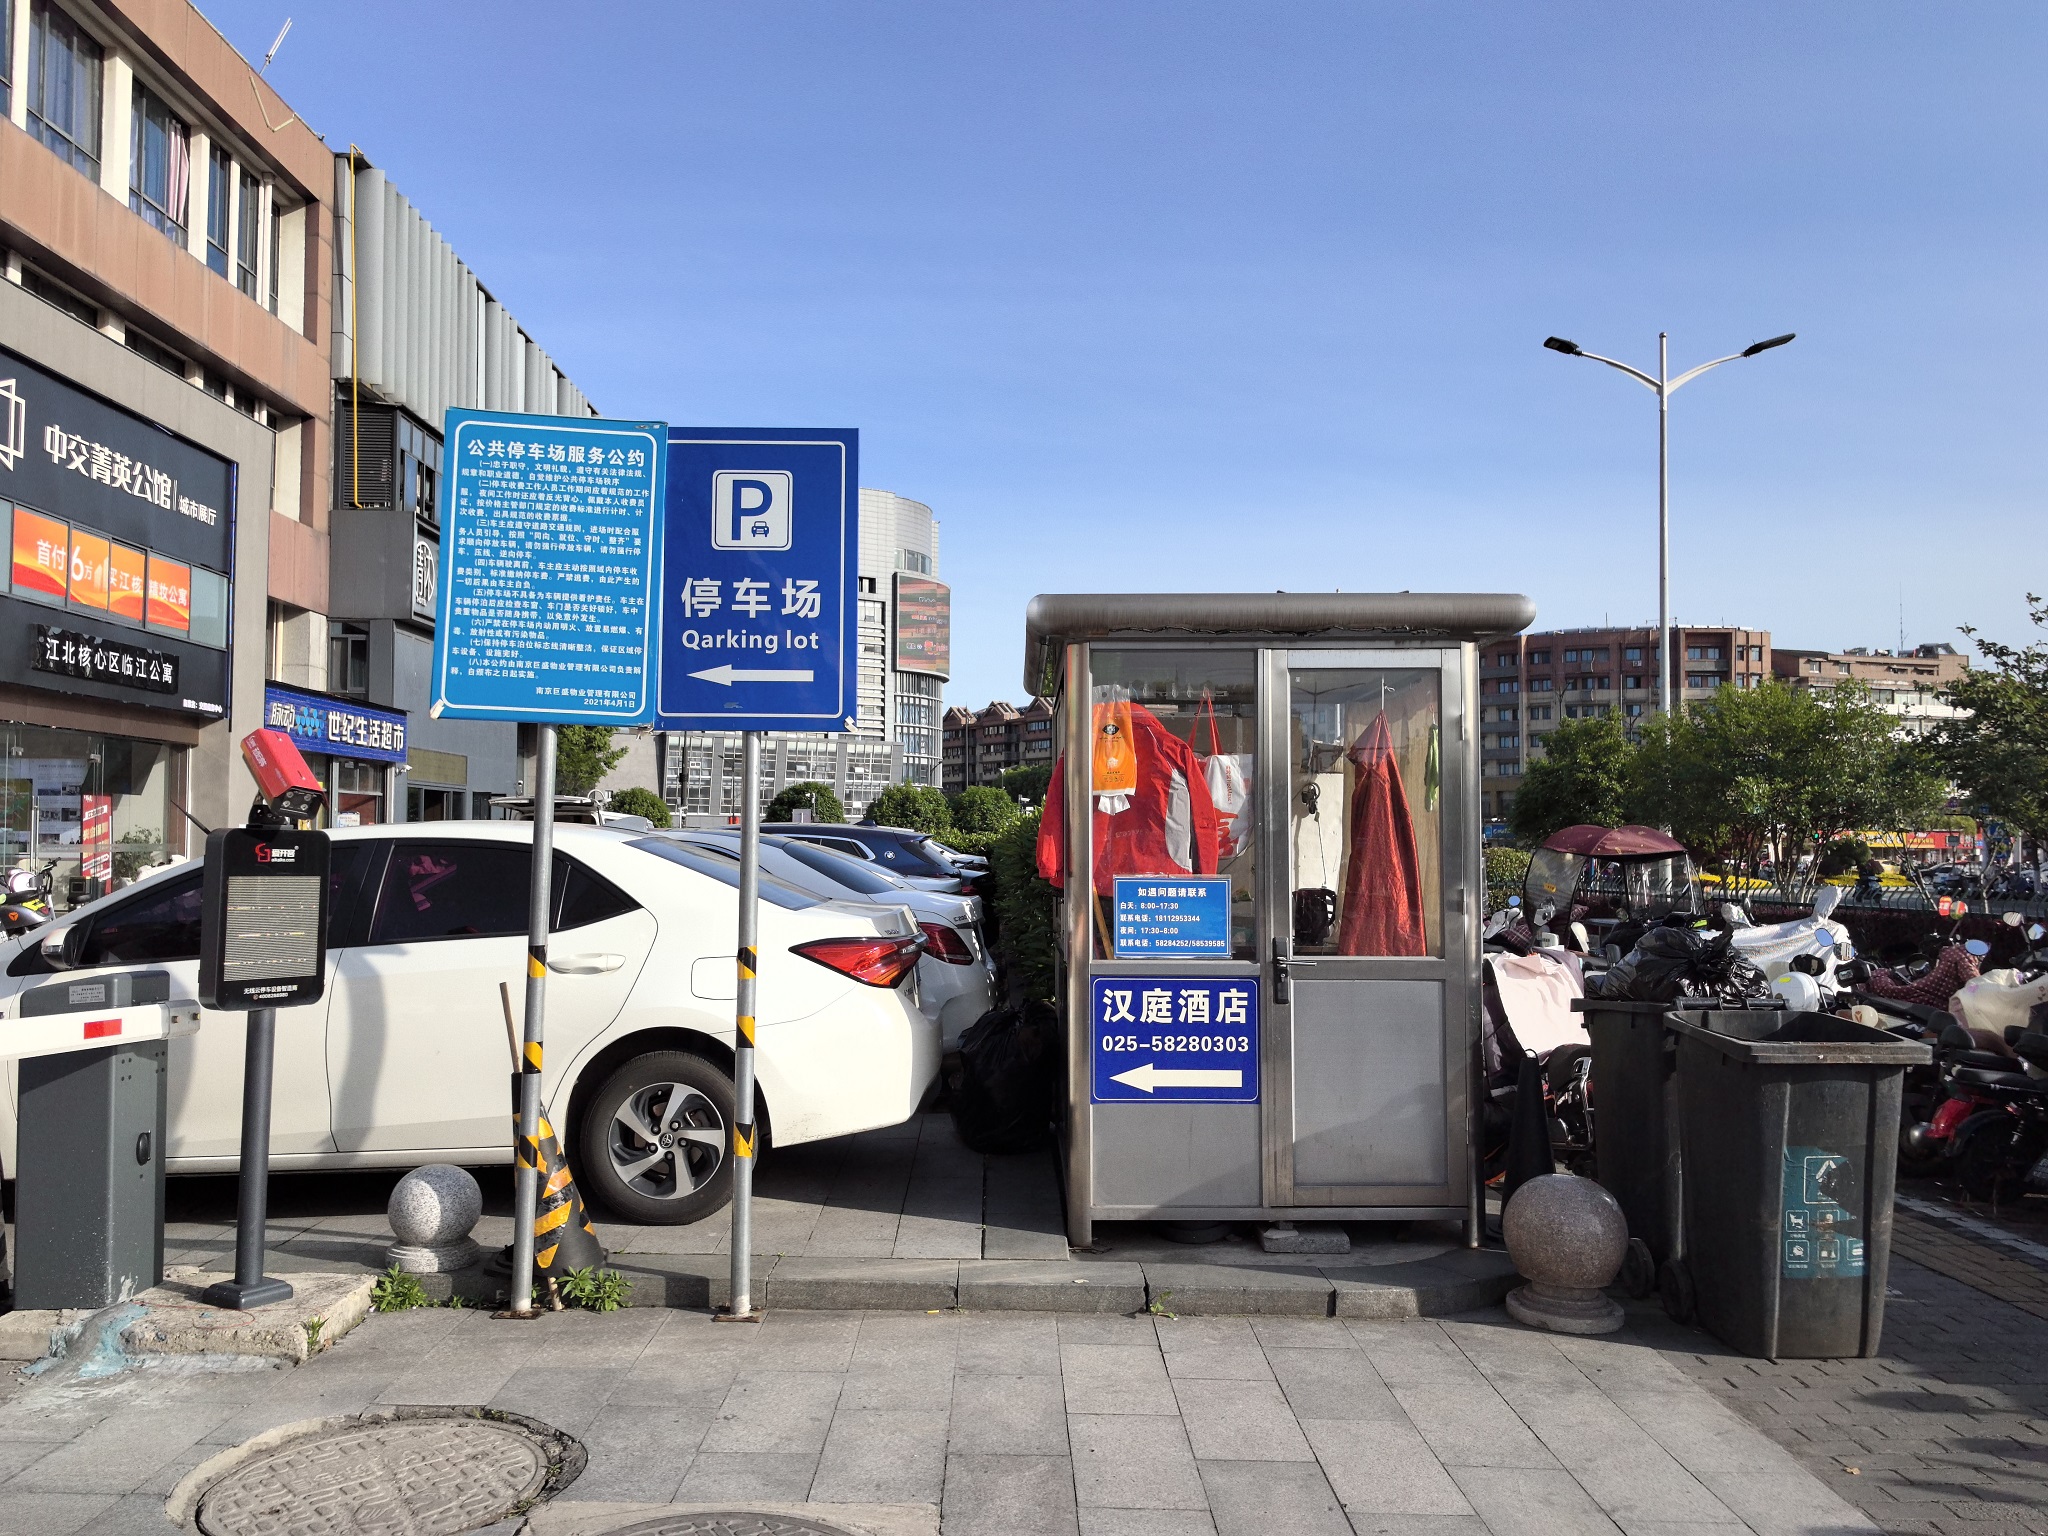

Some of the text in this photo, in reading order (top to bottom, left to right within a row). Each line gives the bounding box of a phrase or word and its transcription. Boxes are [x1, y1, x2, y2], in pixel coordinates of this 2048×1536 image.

[467, 439, 644, 467] 公共停车场服务公约
[44, 424, 217, 527] 中交菁英公馆 城市展厅
[731, 479, 773, 541] P
[680, 576, 821, 619] 停车场
[682, 629, 819, 655] Qarking lot
[45, 636, 173, 684] 江北核心区临江公寓
[535, 686, 637, 699] 南京巨盛物业管理有限公司
[583, 698, 635, 708] 2021年4月1日
[270, 702, 405, 752] 脉动 世纪生活超市
[1138, 887, 1207, 897] 如遇问题请联系
[1102, 988, 1249, 1024] 汉庭酒店
[1103, 1035, 1249, 1052] 025-58280303
